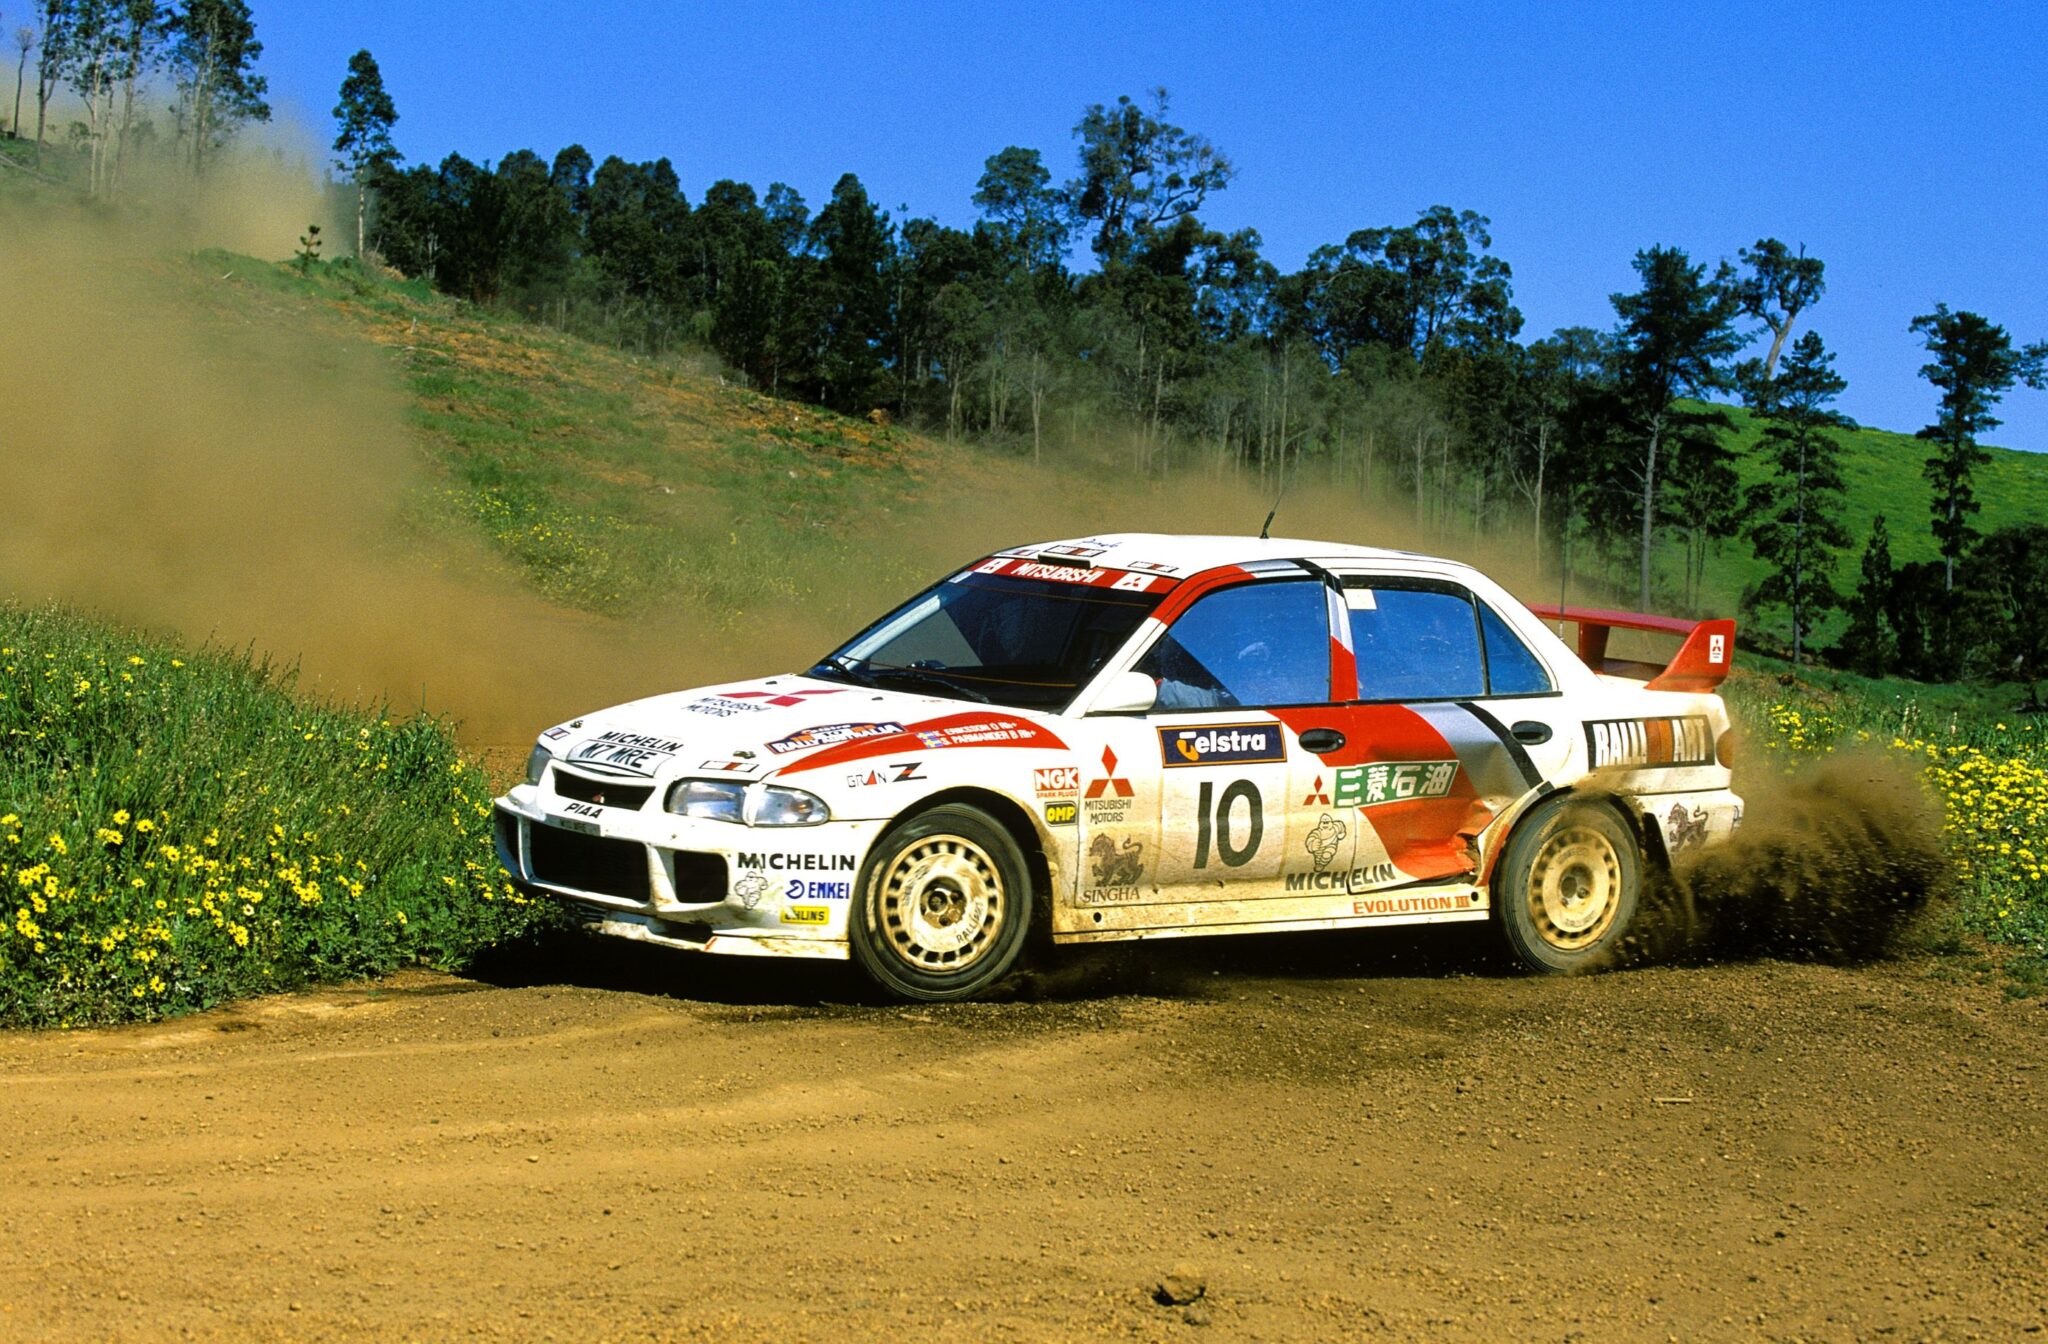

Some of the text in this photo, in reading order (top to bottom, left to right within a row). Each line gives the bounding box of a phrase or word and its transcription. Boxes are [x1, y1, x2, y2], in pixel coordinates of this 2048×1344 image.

[1011, 562, 1105, 583] MITSUBISHI
[598, 731, 684, 752] MICHELIN
[771, 738, 821, 753] RALLY
[1176, 731, 1266, 761] Telstra
[579, 743, 657, 768] M7 MRE
[847, 769, 887, 788] GRAN
[1035, 768, 1078, 790] NGK
[1337, 763, 1453, 807] 三菱石油
[564, 803, 603, 818] PIAA
[1046, 806, 1076, 822] OMP
[1084, 800, 1132, 810] MITSUBISHI
[1090, 812, 1124, 823] MOTORS
[1193, 779, 1263, 869] 10
[738, 852, 855, 870] MICHELIN
[1285, 863, 1396, 891] MICHELIN
[808, 882, 849, 899] ENKEI
[1081, 887, 1140, 903] SINGHA
[1353, 897, 1451, 914] EVOLUTION
